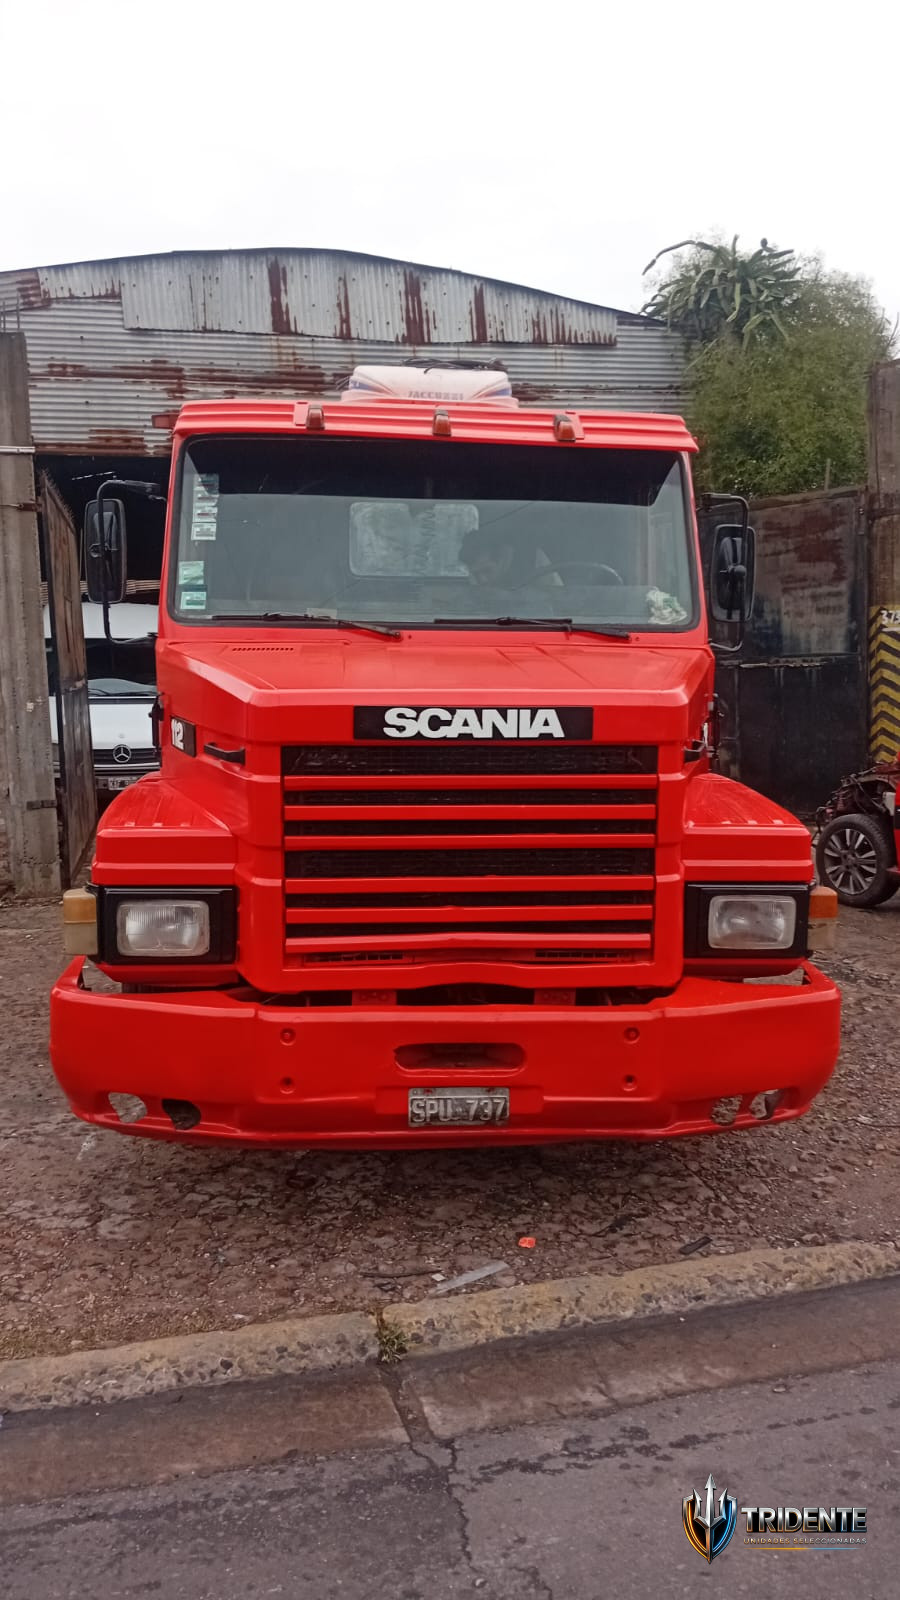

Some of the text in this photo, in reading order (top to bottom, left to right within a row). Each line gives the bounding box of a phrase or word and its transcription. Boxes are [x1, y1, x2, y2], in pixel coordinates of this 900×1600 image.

[383, 707, 565, 738] SCANIA
[412, 1098, 506, 1122] SPU 737
